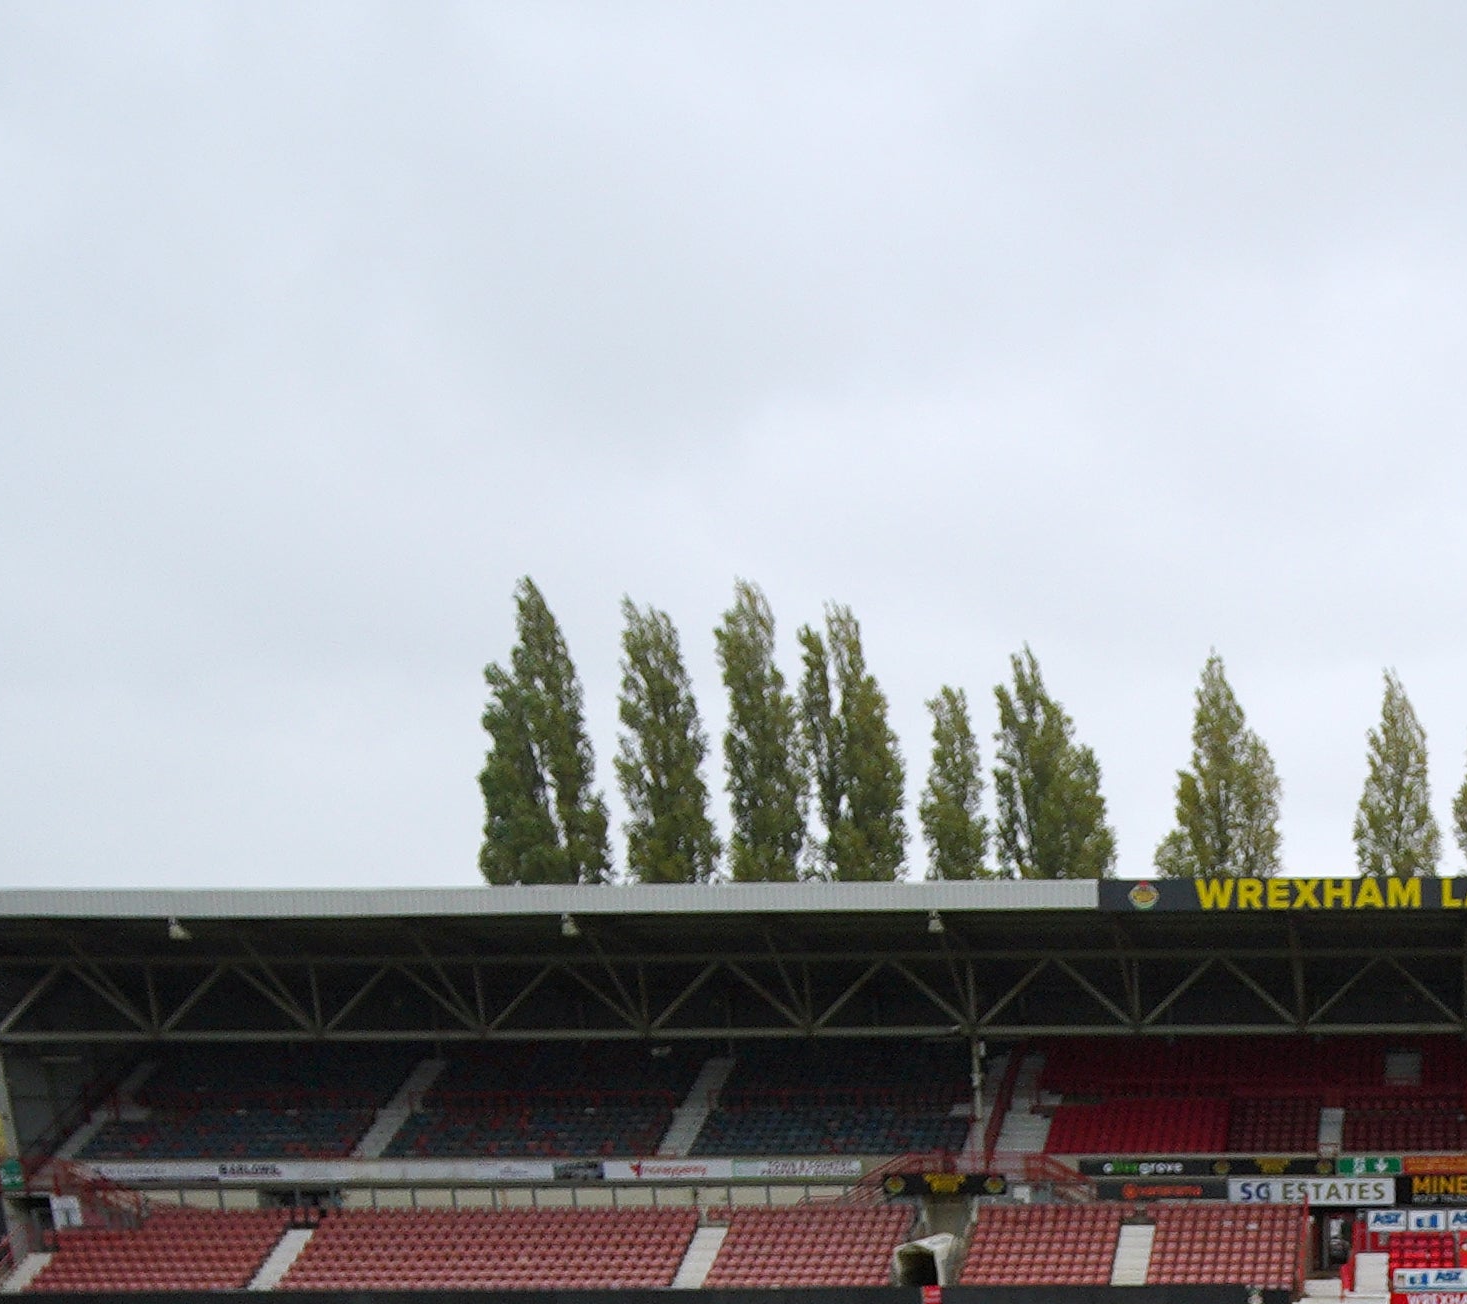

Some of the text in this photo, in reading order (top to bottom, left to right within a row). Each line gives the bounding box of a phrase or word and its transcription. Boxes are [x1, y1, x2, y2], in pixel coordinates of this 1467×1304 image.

[1195, 877, 1422, 910] WREXHAM
[1240, 1182, 1386, 1200] SG ESTATES
